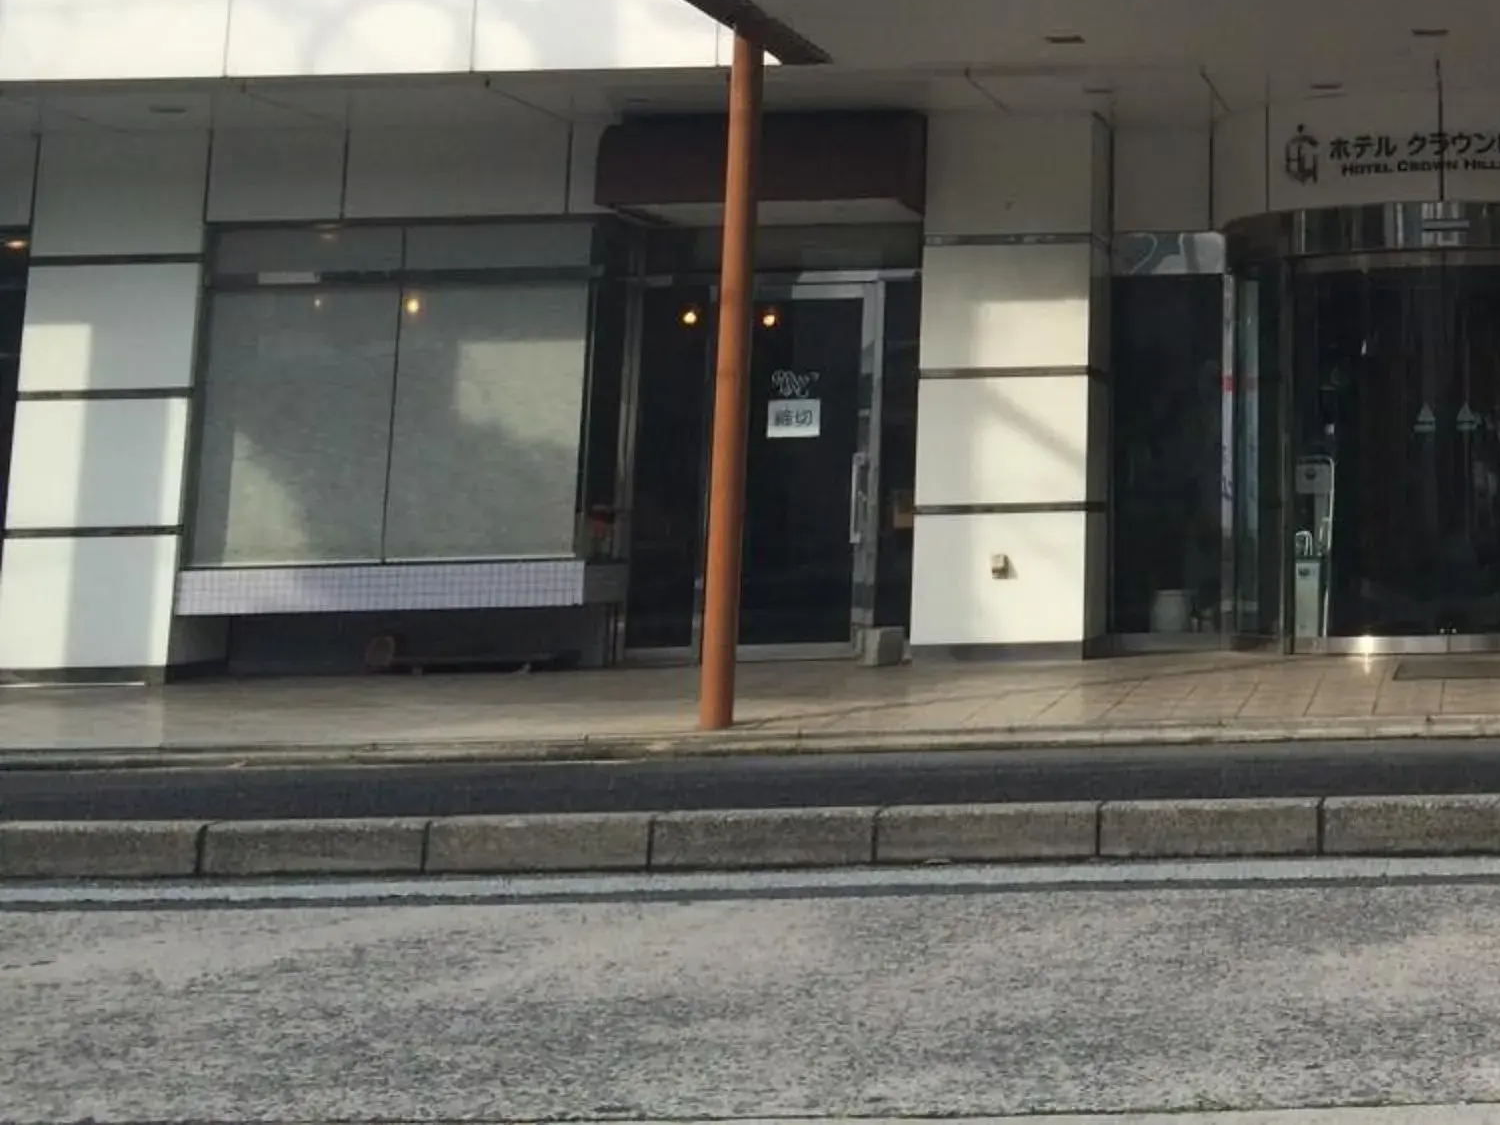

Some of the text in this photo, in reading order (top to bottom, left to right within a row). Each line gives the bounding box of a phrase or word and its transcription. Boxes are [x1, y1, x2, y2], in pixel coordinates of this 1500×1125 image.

[1330, 135, 1397, 160] ホテル
[1341, 162, 1393, 176] HOTEL
